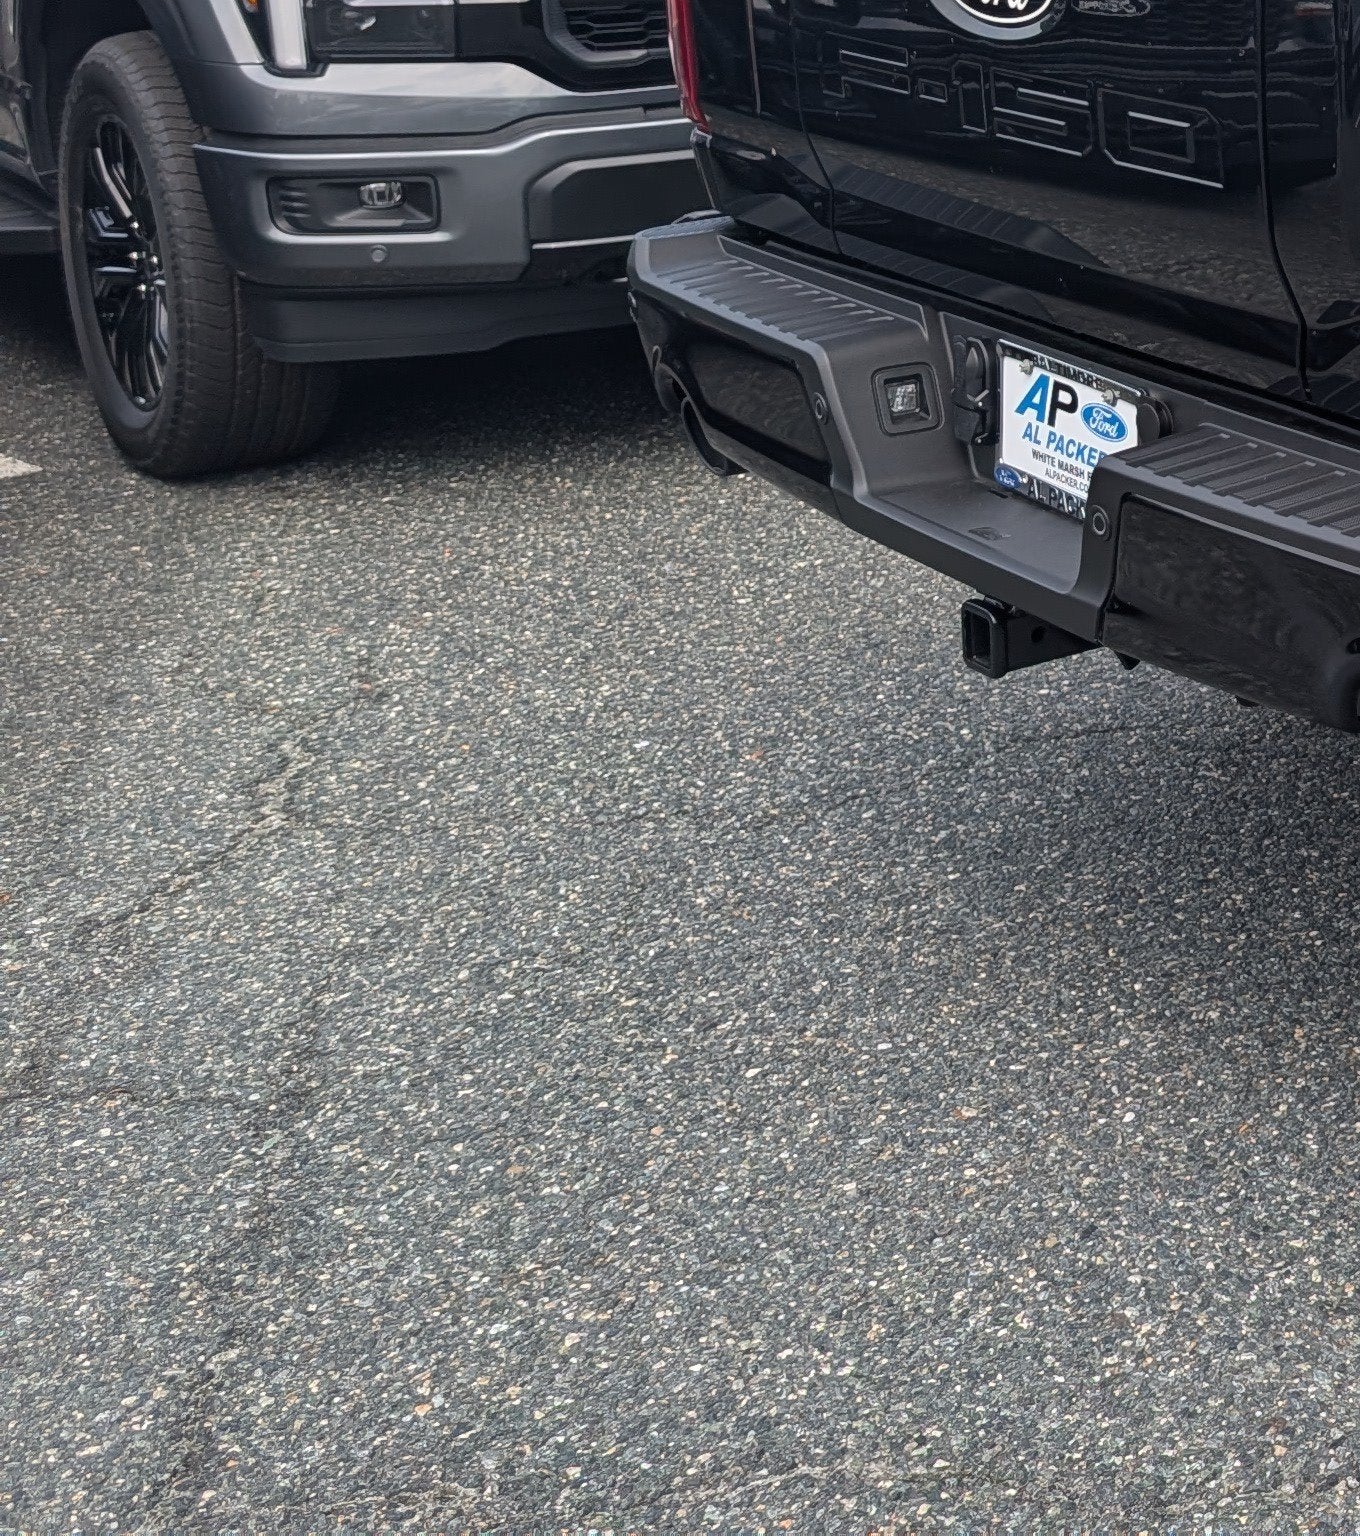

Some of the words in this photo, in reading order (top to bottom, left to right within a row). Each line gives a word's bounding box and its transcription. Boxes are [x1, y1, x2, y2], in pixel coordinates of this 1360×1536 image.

[1014, 373, 1079, 428] AP
[1022, 421, 1041, 445] AL
[1088, 407, 1120, 438] Ford
[1031, 448, 1056, 468] WHITE
[1058, 458, 1085, 480] MARSH
[1045, 467, 1089, 494] ALPACKER.CO
[1028, 477, 1047, 503] AL
[1048, 485, 1087, 520] PACK
